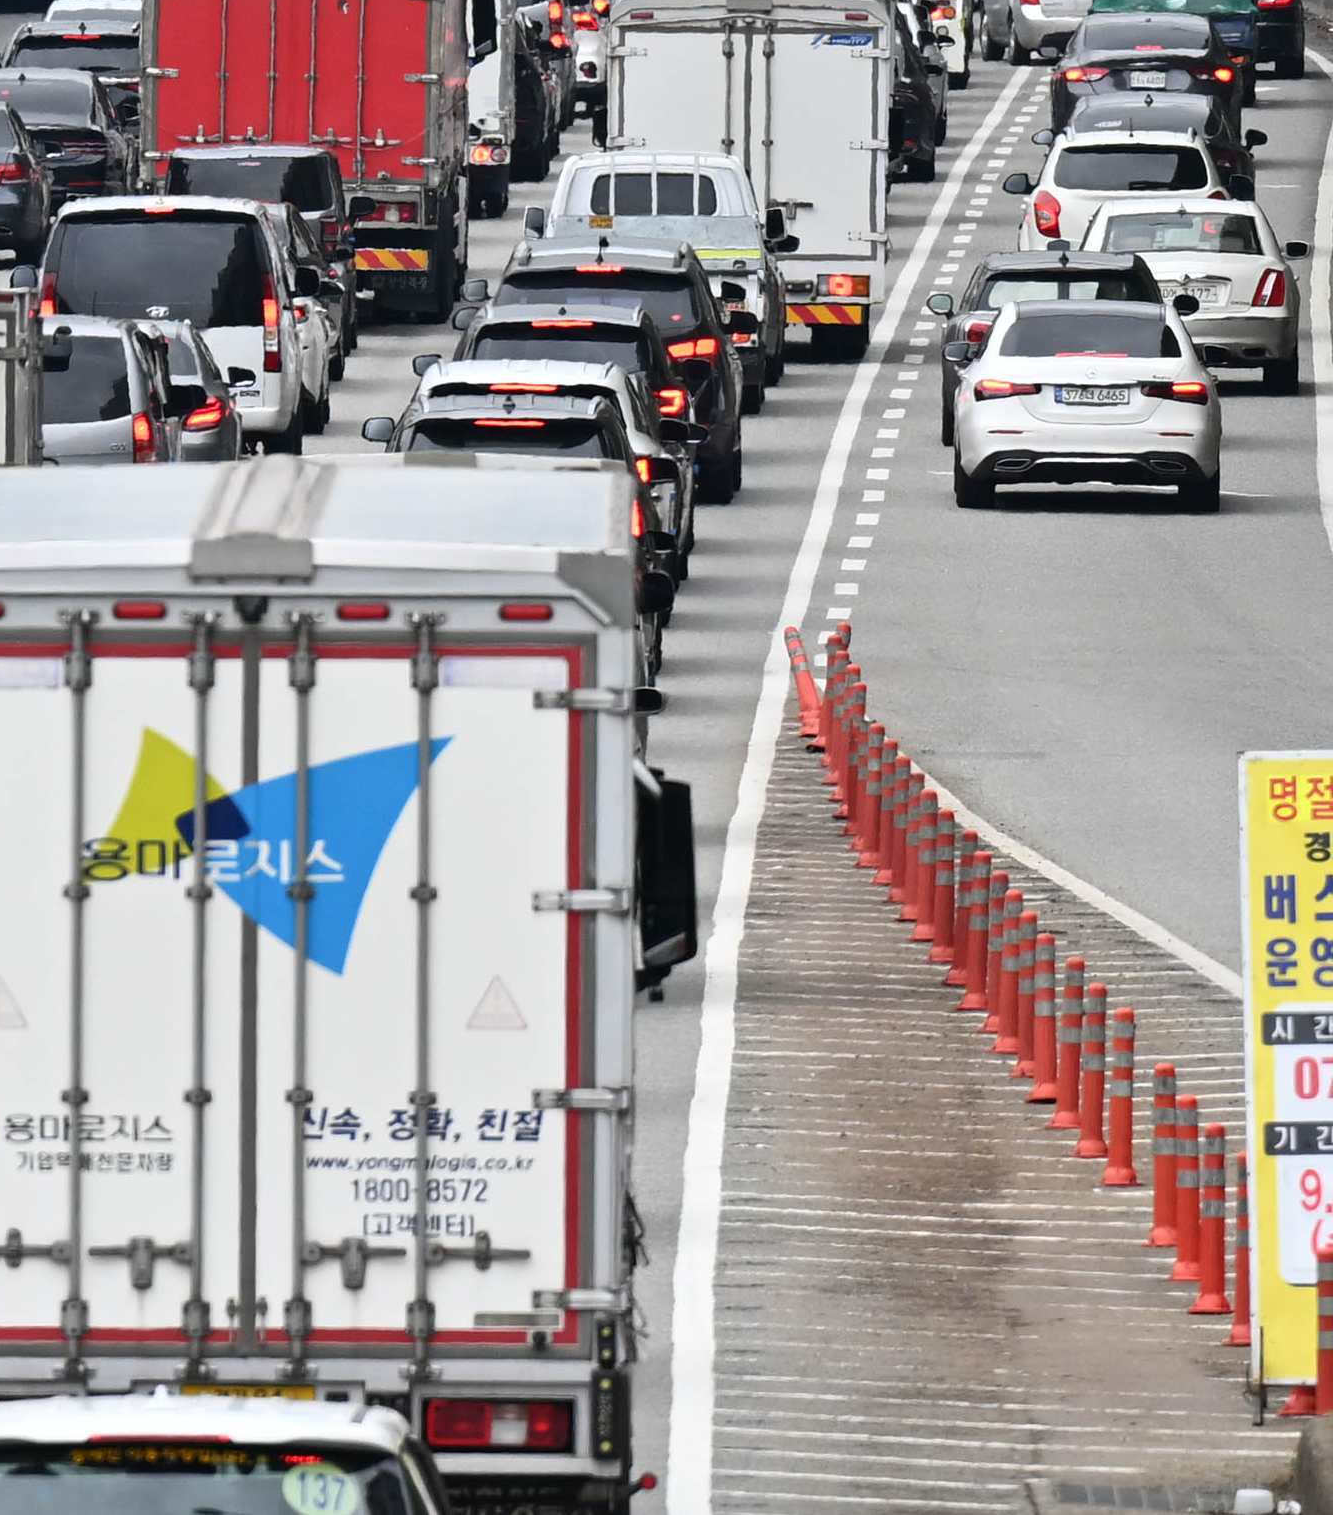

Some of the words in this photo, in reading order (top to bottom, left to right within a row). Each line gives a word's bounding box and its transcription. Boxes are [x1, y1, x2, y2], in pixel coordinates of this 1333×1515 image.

[1097, 388, 1126, 400] 6465
[83, 837, 345, 883] 용마로지스
[4, 1113, 173, 1142] 용마로지스
[303, 1107, 370, 1142] 신속,
[388, 1108, 461, 1143] 정확,
[477, 1108, 543, 1142] 친절
[297, 1470, 348, 1510] 137
